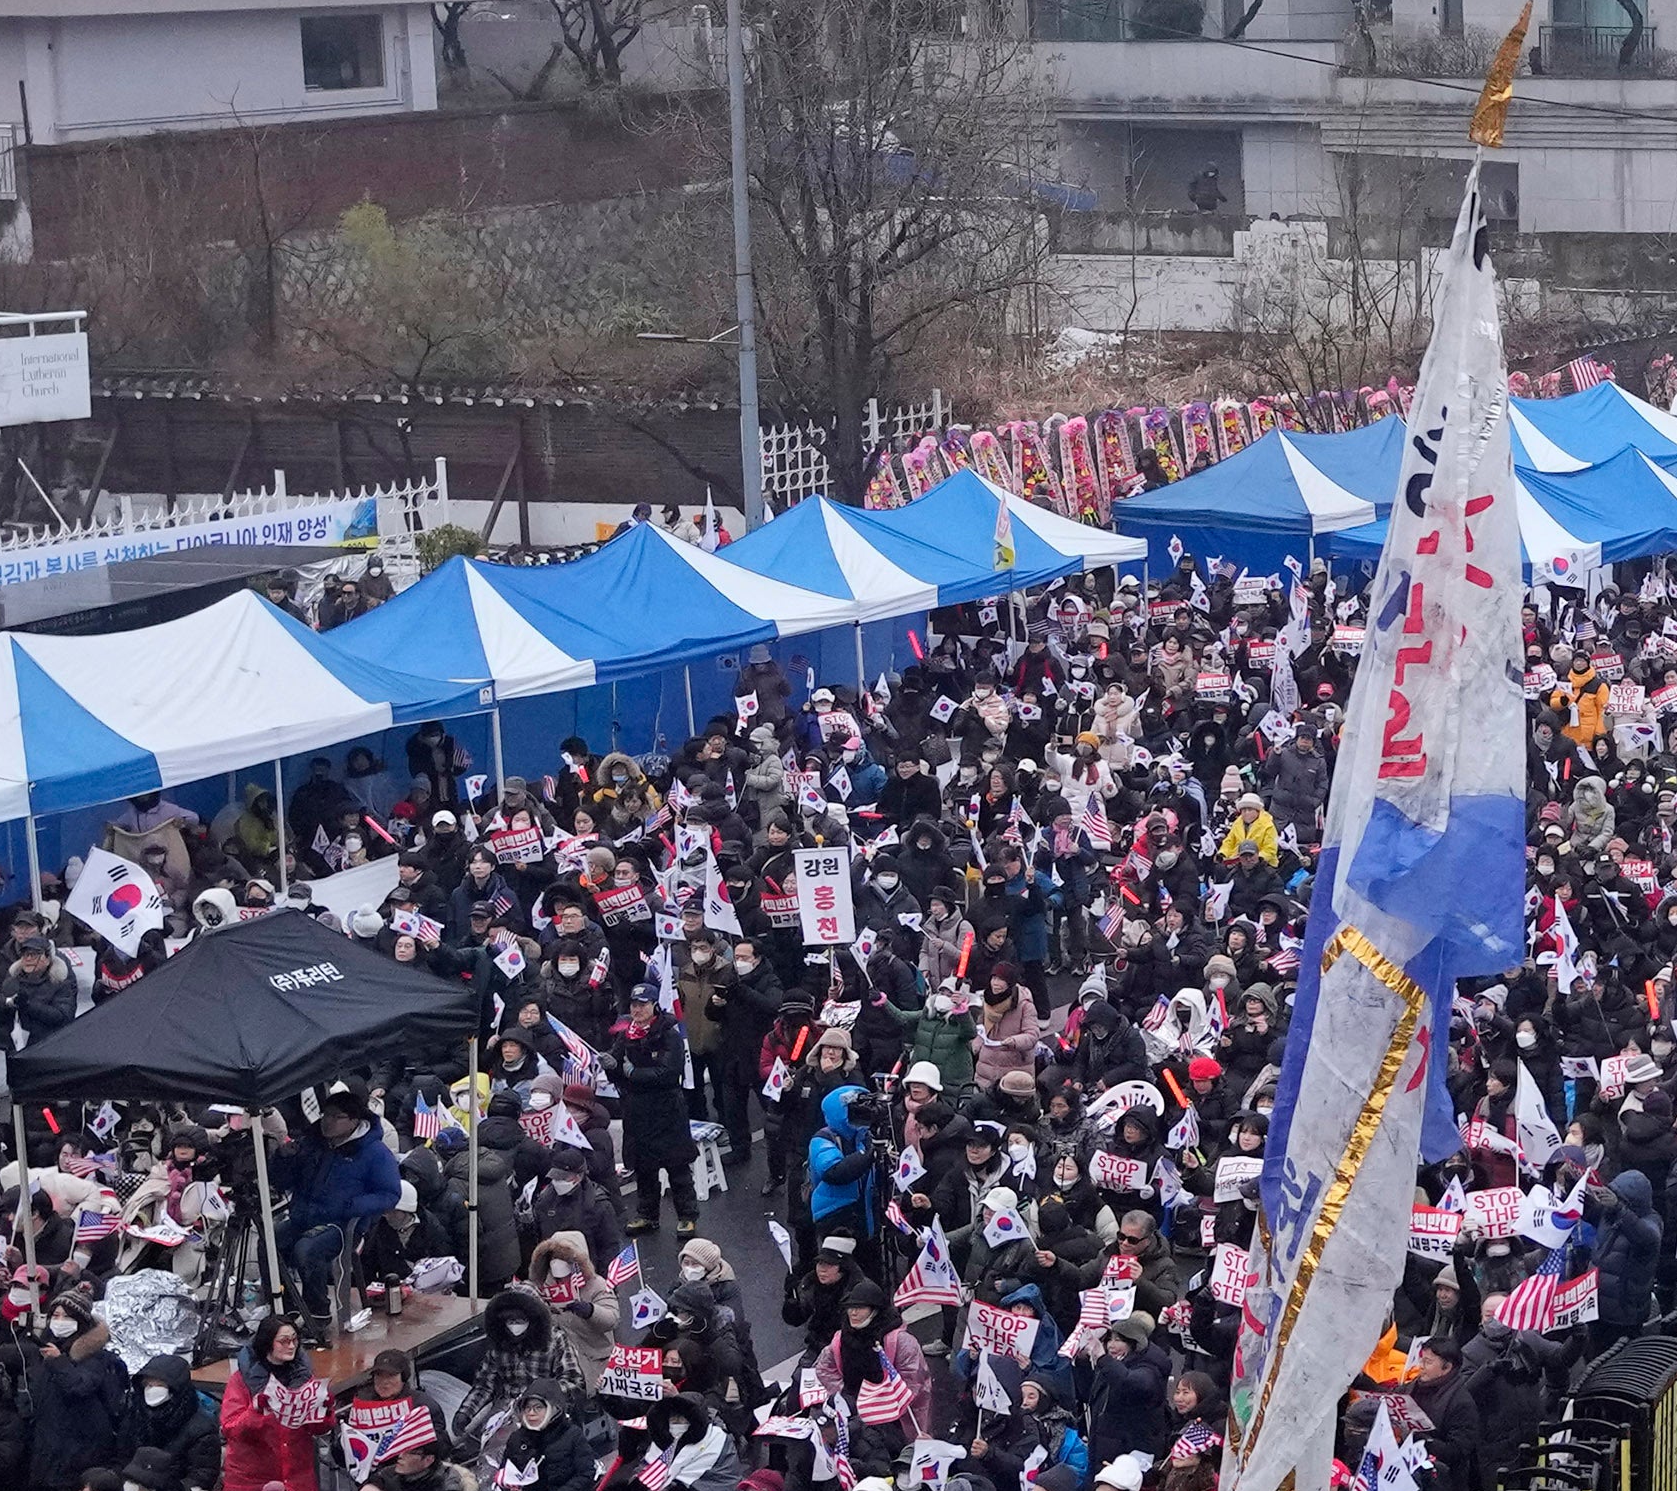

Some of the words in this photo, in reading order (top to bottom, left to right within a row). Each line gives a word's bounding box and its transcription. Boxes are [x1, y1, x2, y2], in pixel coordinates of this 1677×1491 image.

[20, 350, 80, 366] International
[21, 368, 67, 381] Lutheran
[22, 383, 60, 398] Church
[1613, 687, 1640, 697] STOP
[1617, 696, 1637, 704] THE
[804, 856, 839, 876] 강원
[814, 885, 838, 940] 홍천
[269, 961, 343, 993] (주)퓨리턴
[1098, 1153, 1140, 1173] STOP
[1474, 1187, 1524, 1209] STOP
[1224, 1247, 1249, 1270] STO
[977, 1309, 1029, 1334] STOP
[983, 1324, 1017, 1348] THE
[614, 1367, 639, 1379] OUT
[274, 1379, 321, 1401] STOP
[602, 1376, 661, 1400] 가짜국회
